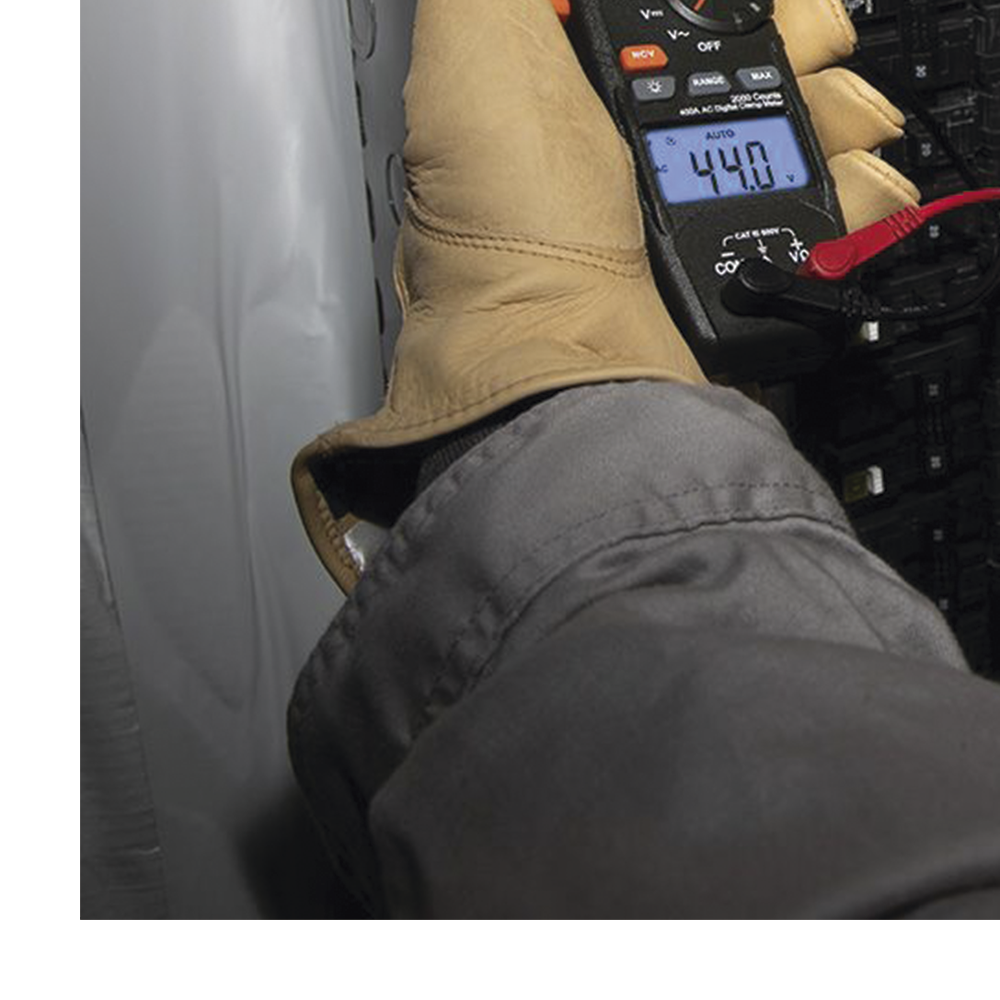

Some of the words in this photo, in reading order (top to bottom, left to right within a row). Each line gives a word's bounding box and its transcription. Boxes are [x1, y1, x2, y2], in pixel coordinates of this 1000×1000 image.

[697, 40, 721, 52] OFF
[692, 75, 725, 87] RANGE
[750, 71, 773, 81] MAX
[752, 91, 782, 101] Counts
[701, 105, 714, 114] AC
[714, 103, 738, 113] Digital
[705, 128, 736, 141] AUTO
[689, 140, 776, 196] 44.0
[786, 173, 795, 183] V
[734, 231, 750, 241] CAT
